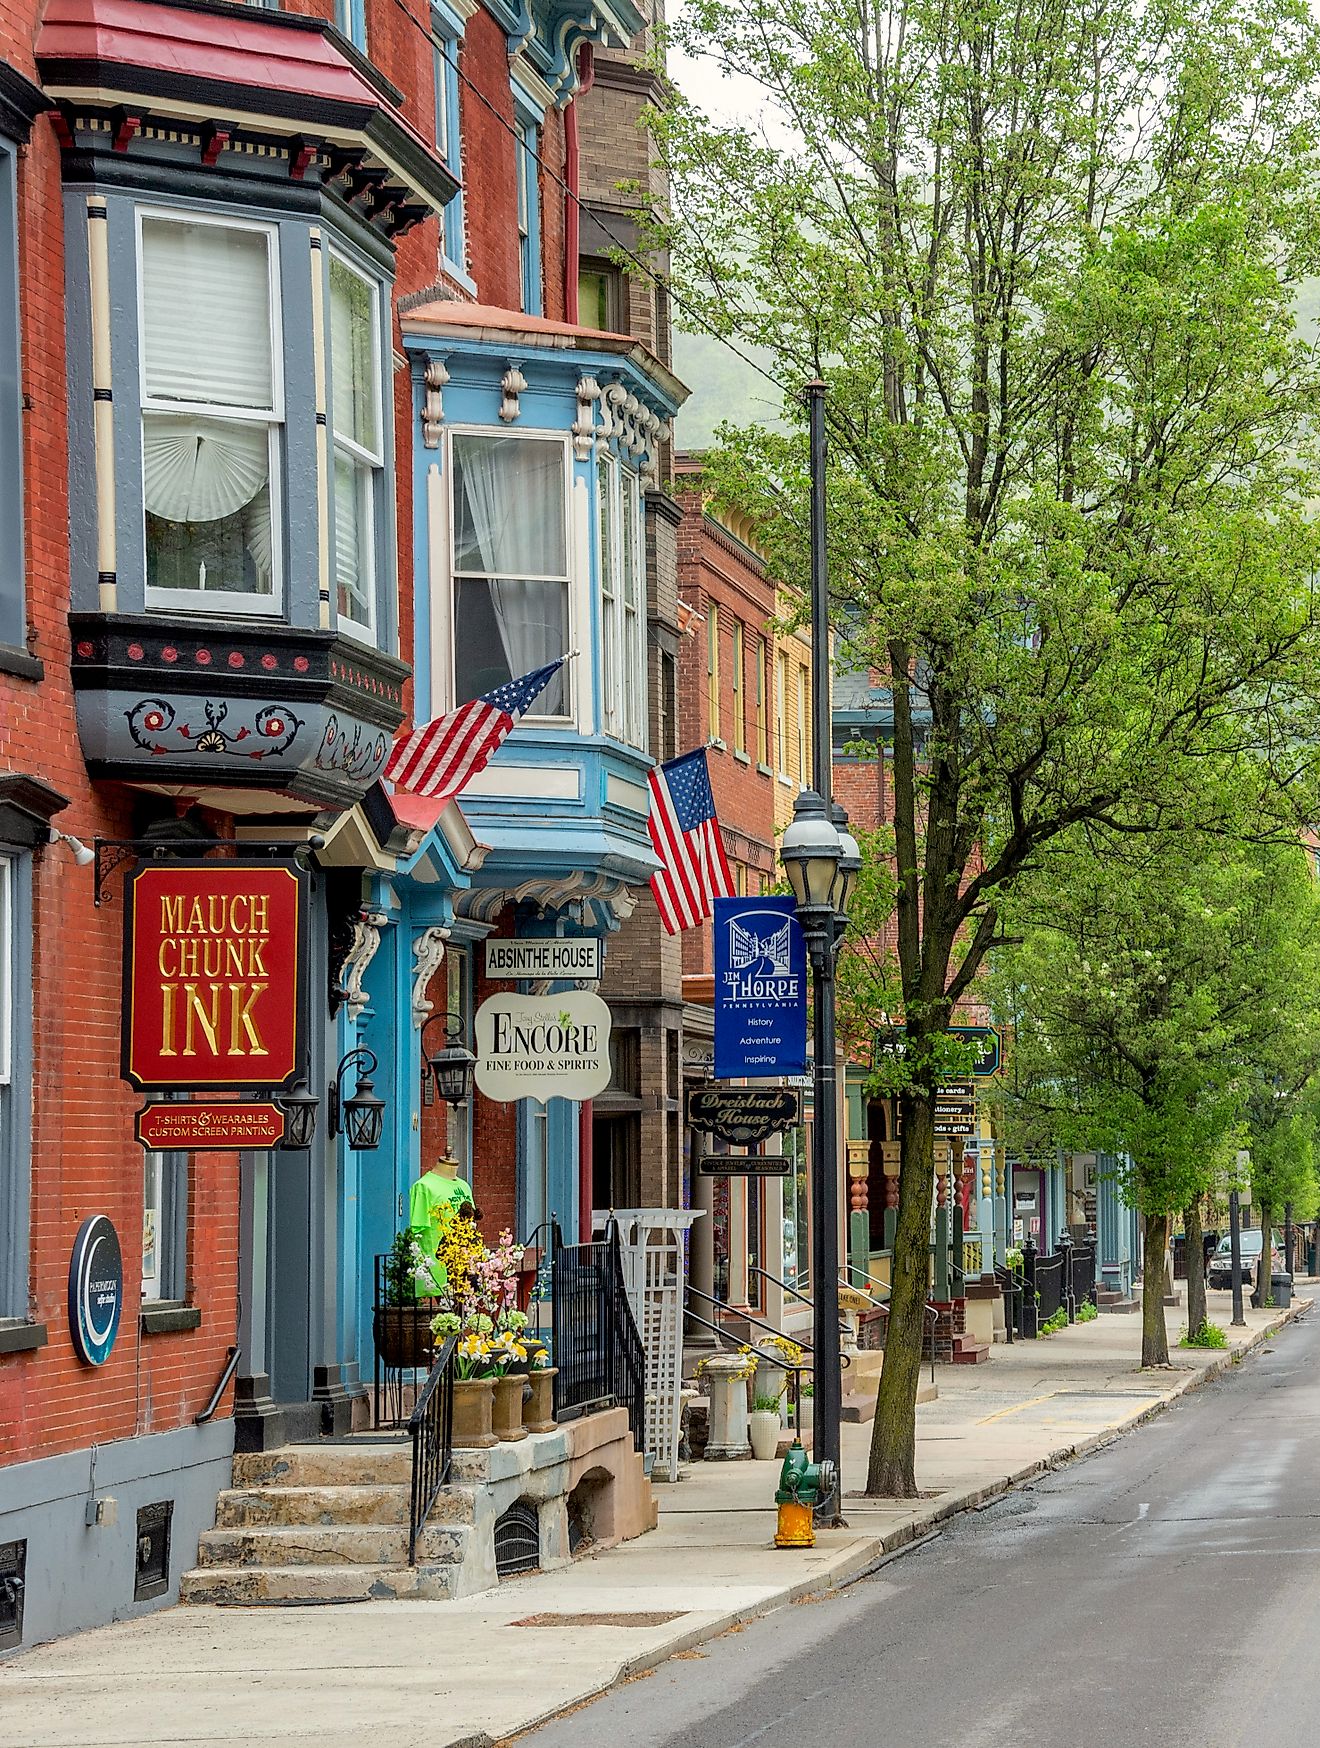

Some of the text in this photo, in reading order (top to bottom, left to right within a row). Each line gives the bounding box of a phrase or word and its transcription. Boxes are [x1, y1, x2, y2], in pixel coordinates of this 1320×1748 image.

[159, 894, 269, 934] MAUCH
[158, 937, 269, 978] CHUNK
[489, 947, 594, 969] ABSINTHE HOUSE
[723, 972, 740, 983] JIM
[727, 973, 798, 1001] THORPE
[159, 982, 269, 1056] INK
[748, 1018, 773, 1027] History
[490, 1012, 597, 1055] ENCORE
[739, 1037, 781, 1045] Adventure
[486, 1060, 599, 1071] FINE FOOD & SPIRITS
[744, 1055, 776, 1065] Inspiring
[700, 1093, 785, 1108] Dreisbach
[715, 1109, 770, 1124] House
[935, 1106, 962, 1114] tionery
[155, 1111, 269, 1126] T-SHIRTS & WEARABLES
[148, 1126, 275, 1137] CUSTOM SCREEN PRINTING
[952, 1124, 969, 1133] gifts
